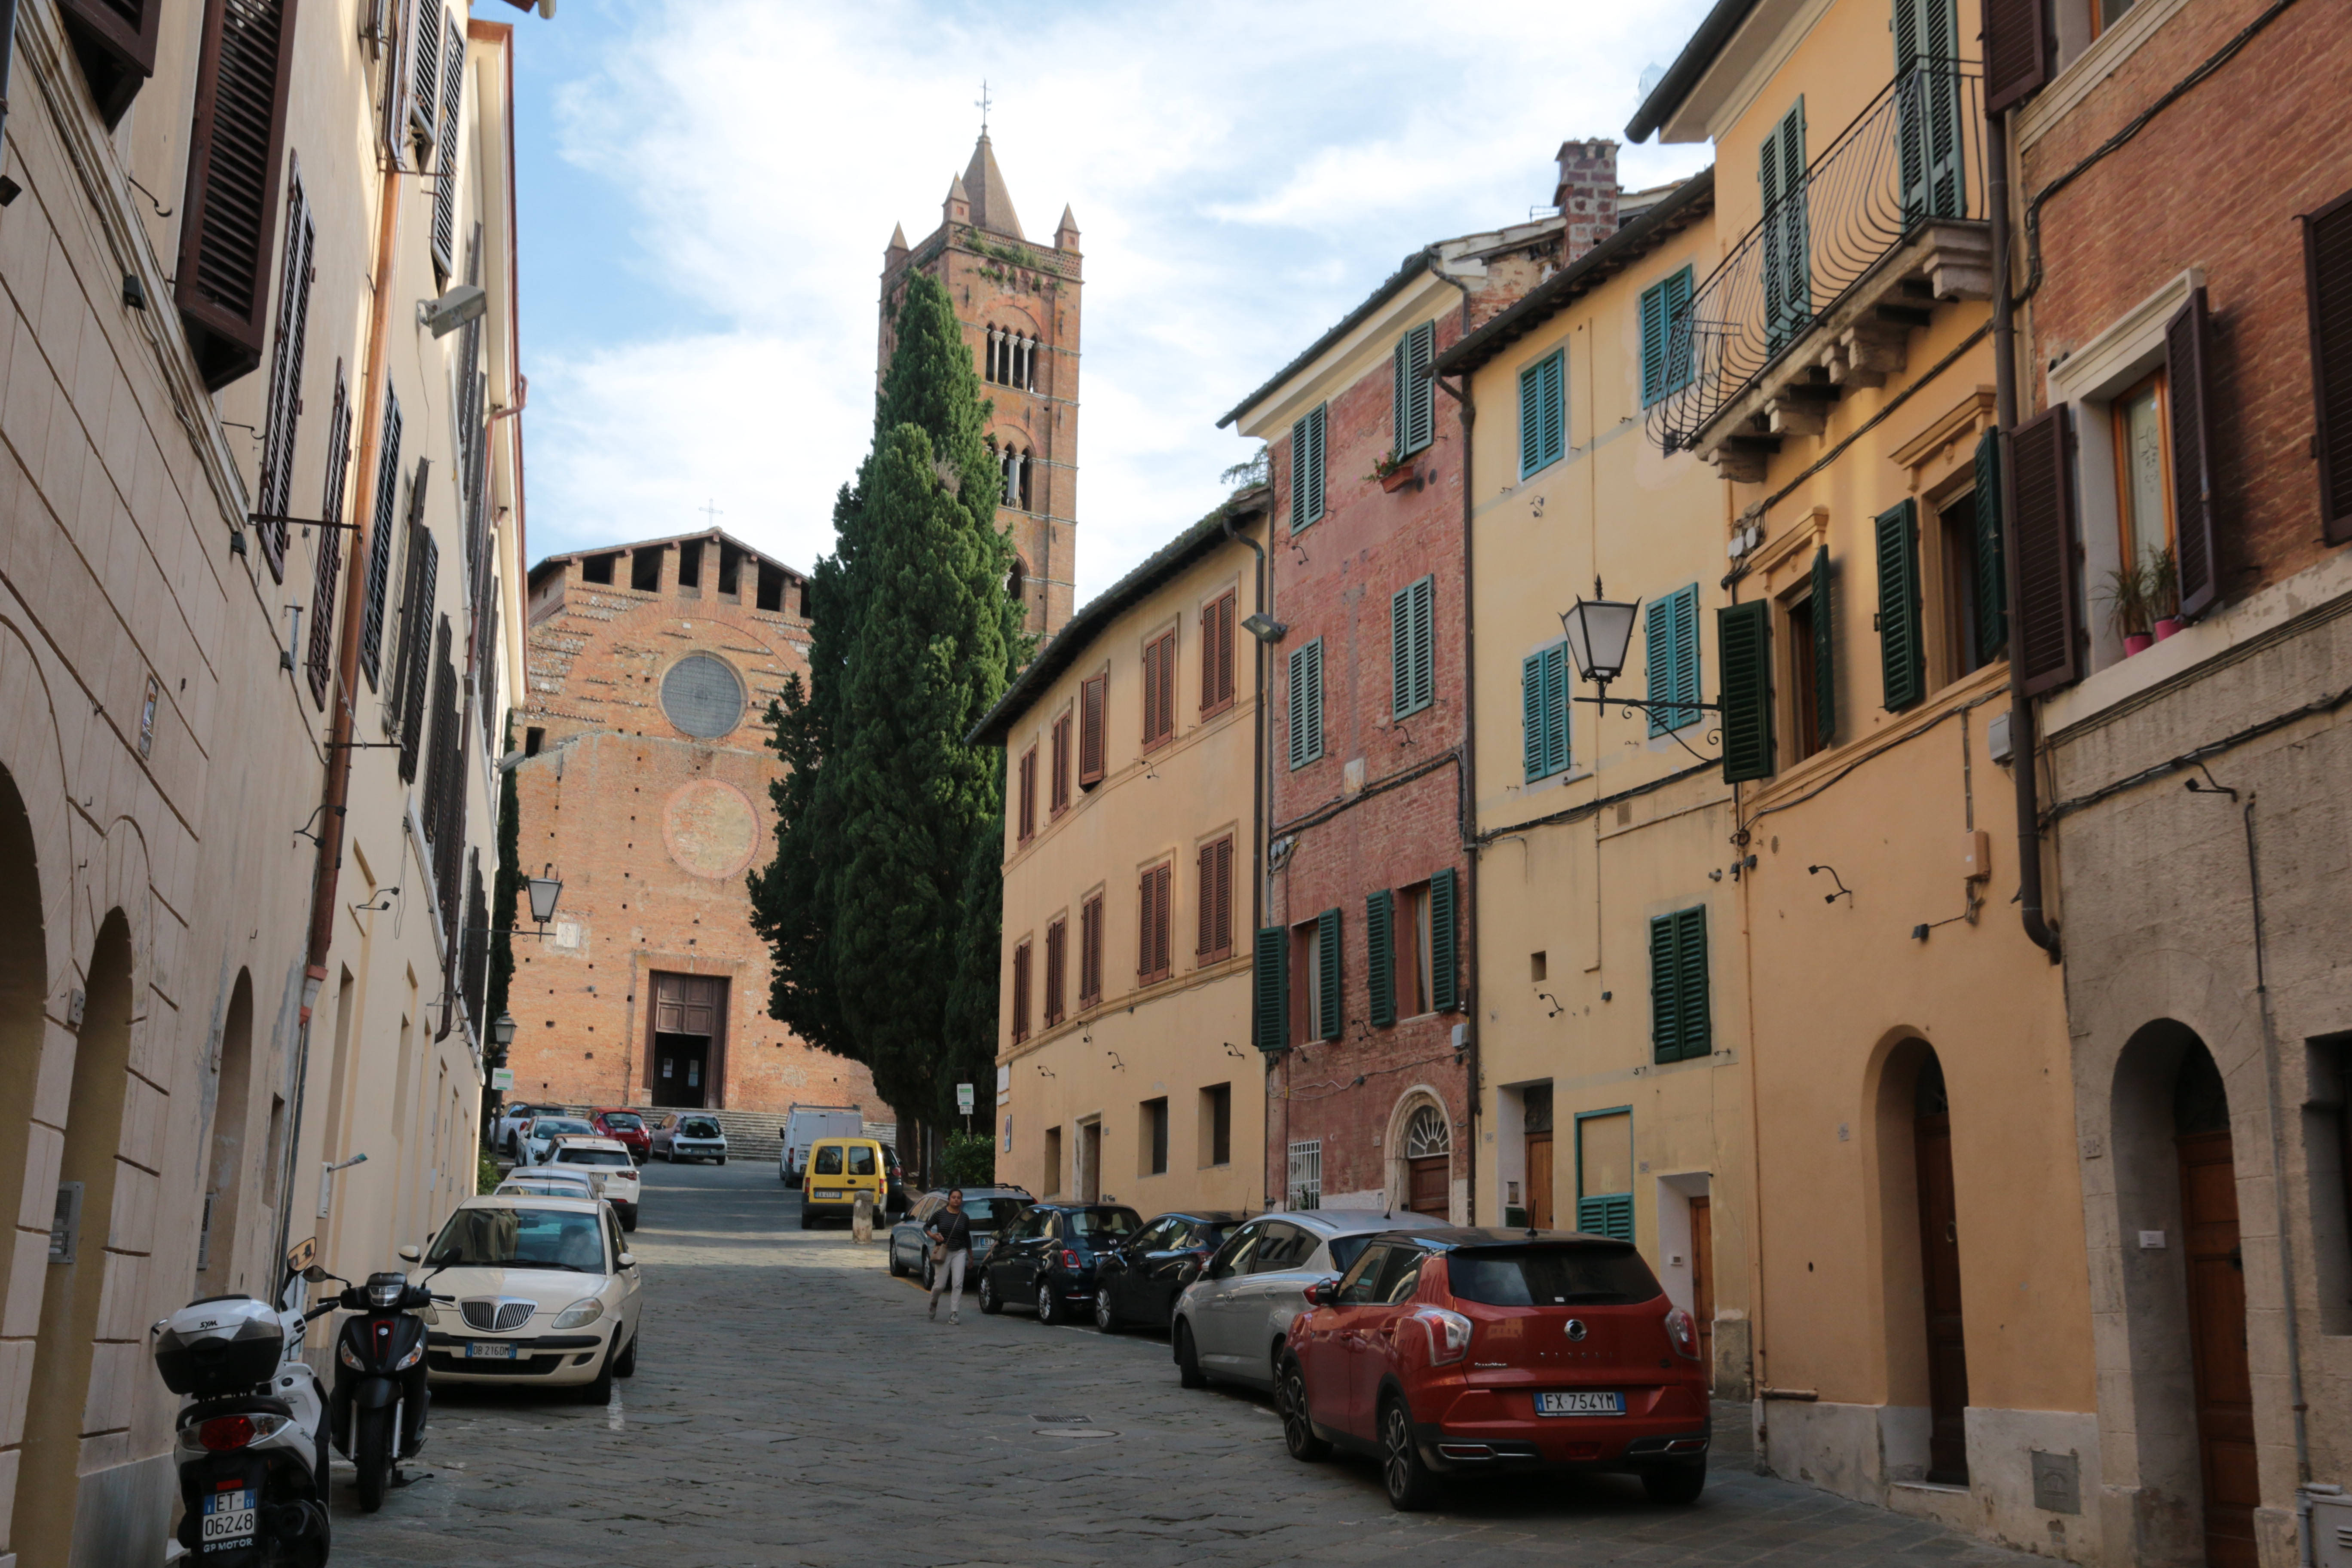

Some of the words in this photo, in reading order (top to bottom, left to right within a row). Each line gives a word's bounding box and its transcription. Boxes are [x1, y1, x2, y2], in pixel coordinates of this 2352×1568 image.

[199, 1320, 218, 1329] SYM
[473, 1346, 482, 1355] DB
[485, 1346, 509, 1356] 216DM
[1545, 1394, 1564, 1409] FX
[1569, 1393, 1615, 1409] 754YM
[216, 1493, 235, 1512] ET
[246, 1498, 254, 1507] SI
[205, 1513, 253, 1537] 06248
[203, 1543, 216, 1553] GP
[218, 1537, 253, 1550] MOTOR
